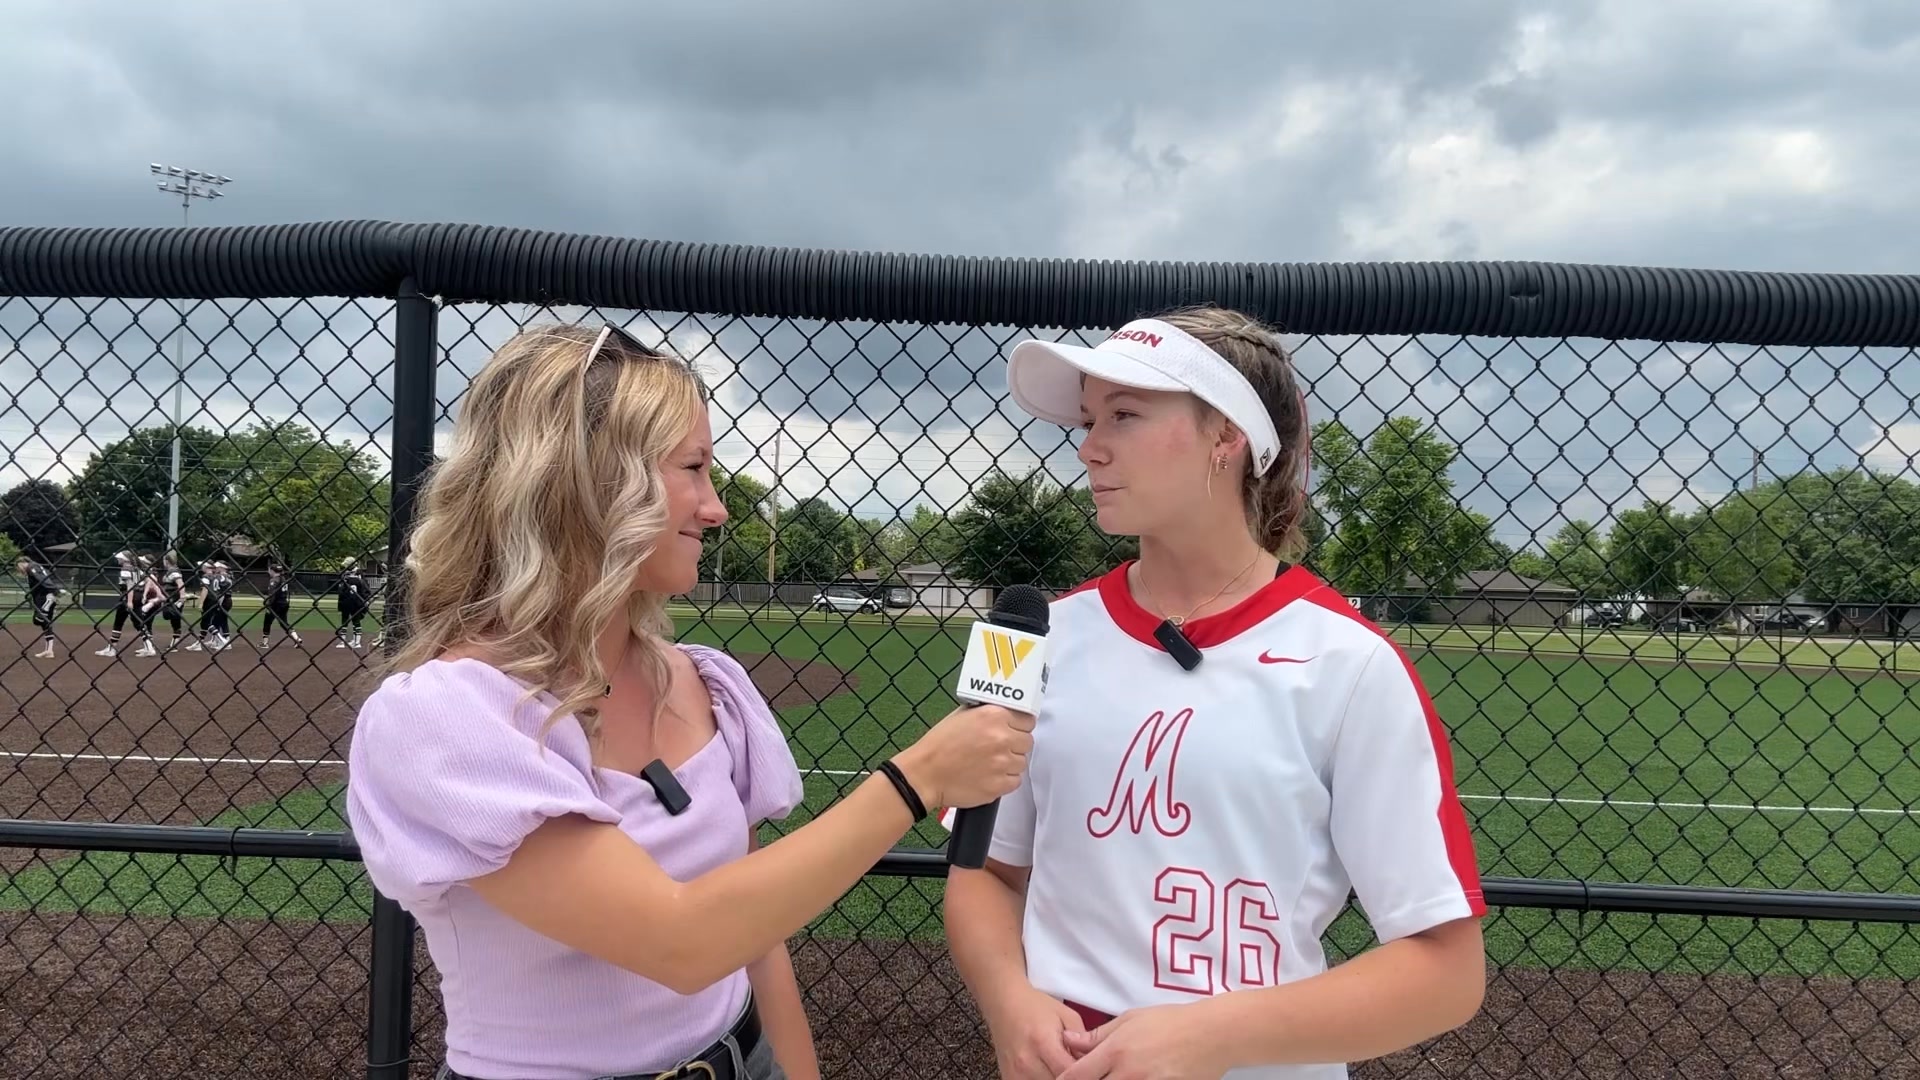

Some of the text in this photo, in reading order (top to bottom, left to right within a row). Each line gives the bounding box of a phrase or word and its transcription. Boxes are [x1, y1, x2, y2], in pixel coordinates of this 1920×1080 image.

[969, 677, 1024, 701] WATCO
[1087, 708, 1193, 838] M
[1152, 866, 1280, 996] 26
